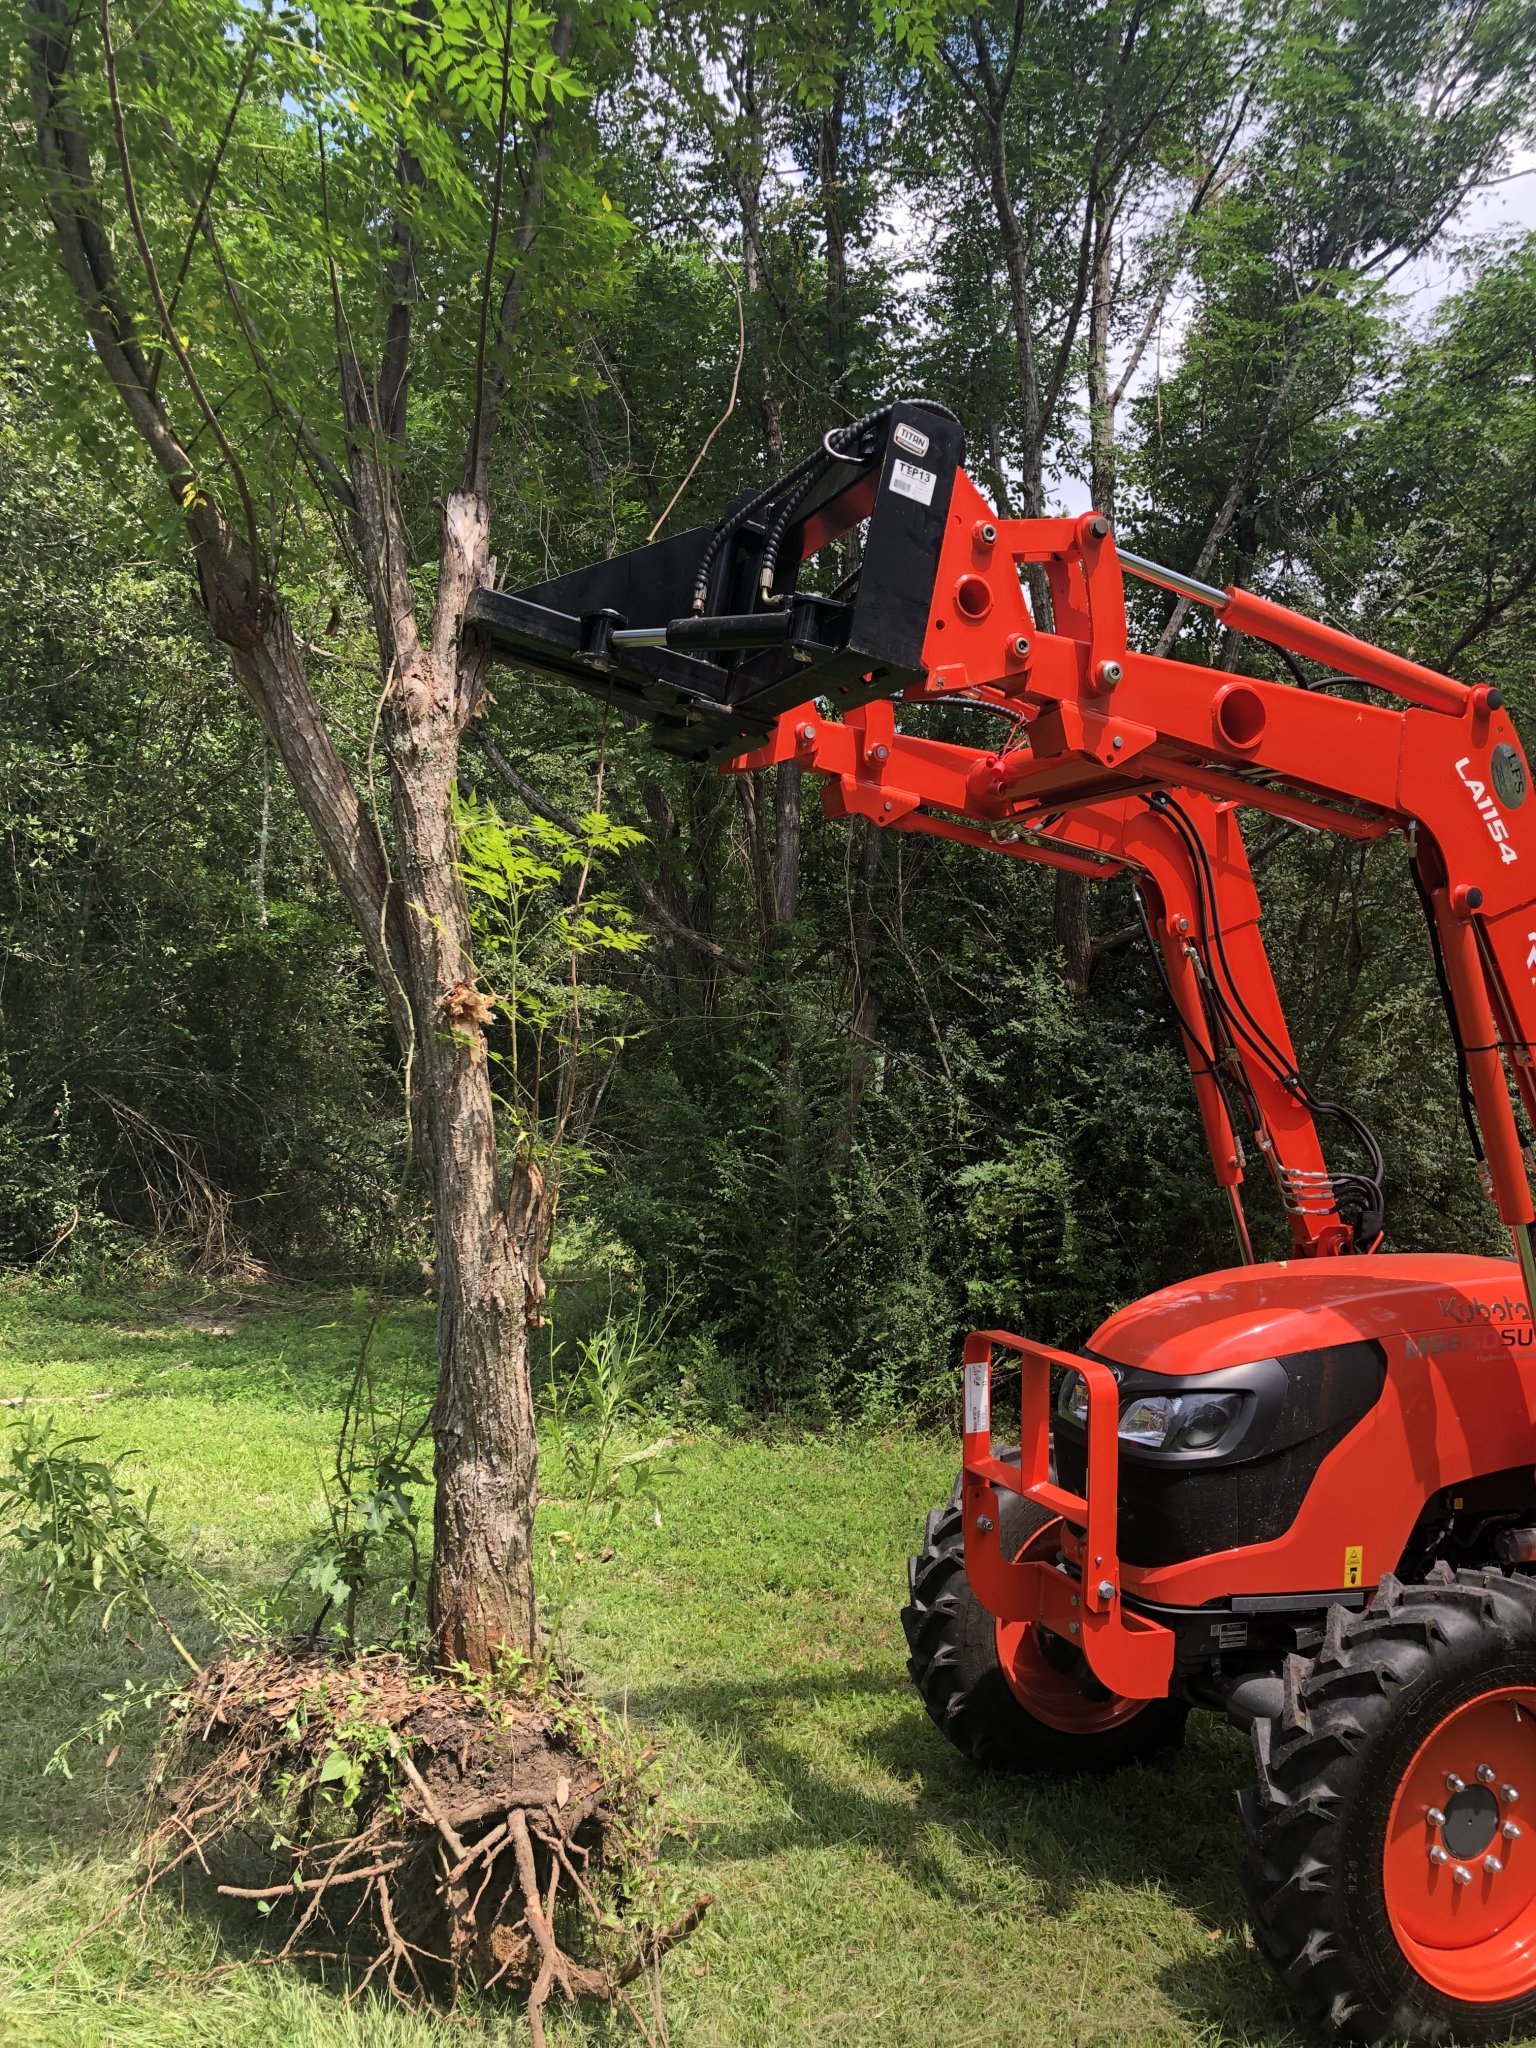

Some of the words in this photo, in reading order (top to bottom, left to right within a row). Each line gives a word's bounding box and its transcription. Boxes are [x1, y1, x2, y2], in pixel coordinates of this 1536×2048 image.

[901, 428, 926, 448] TITAN
[1455, 757, 1518, 865] LA1154
[1438, 1295, 1531, 1324] Kubota
